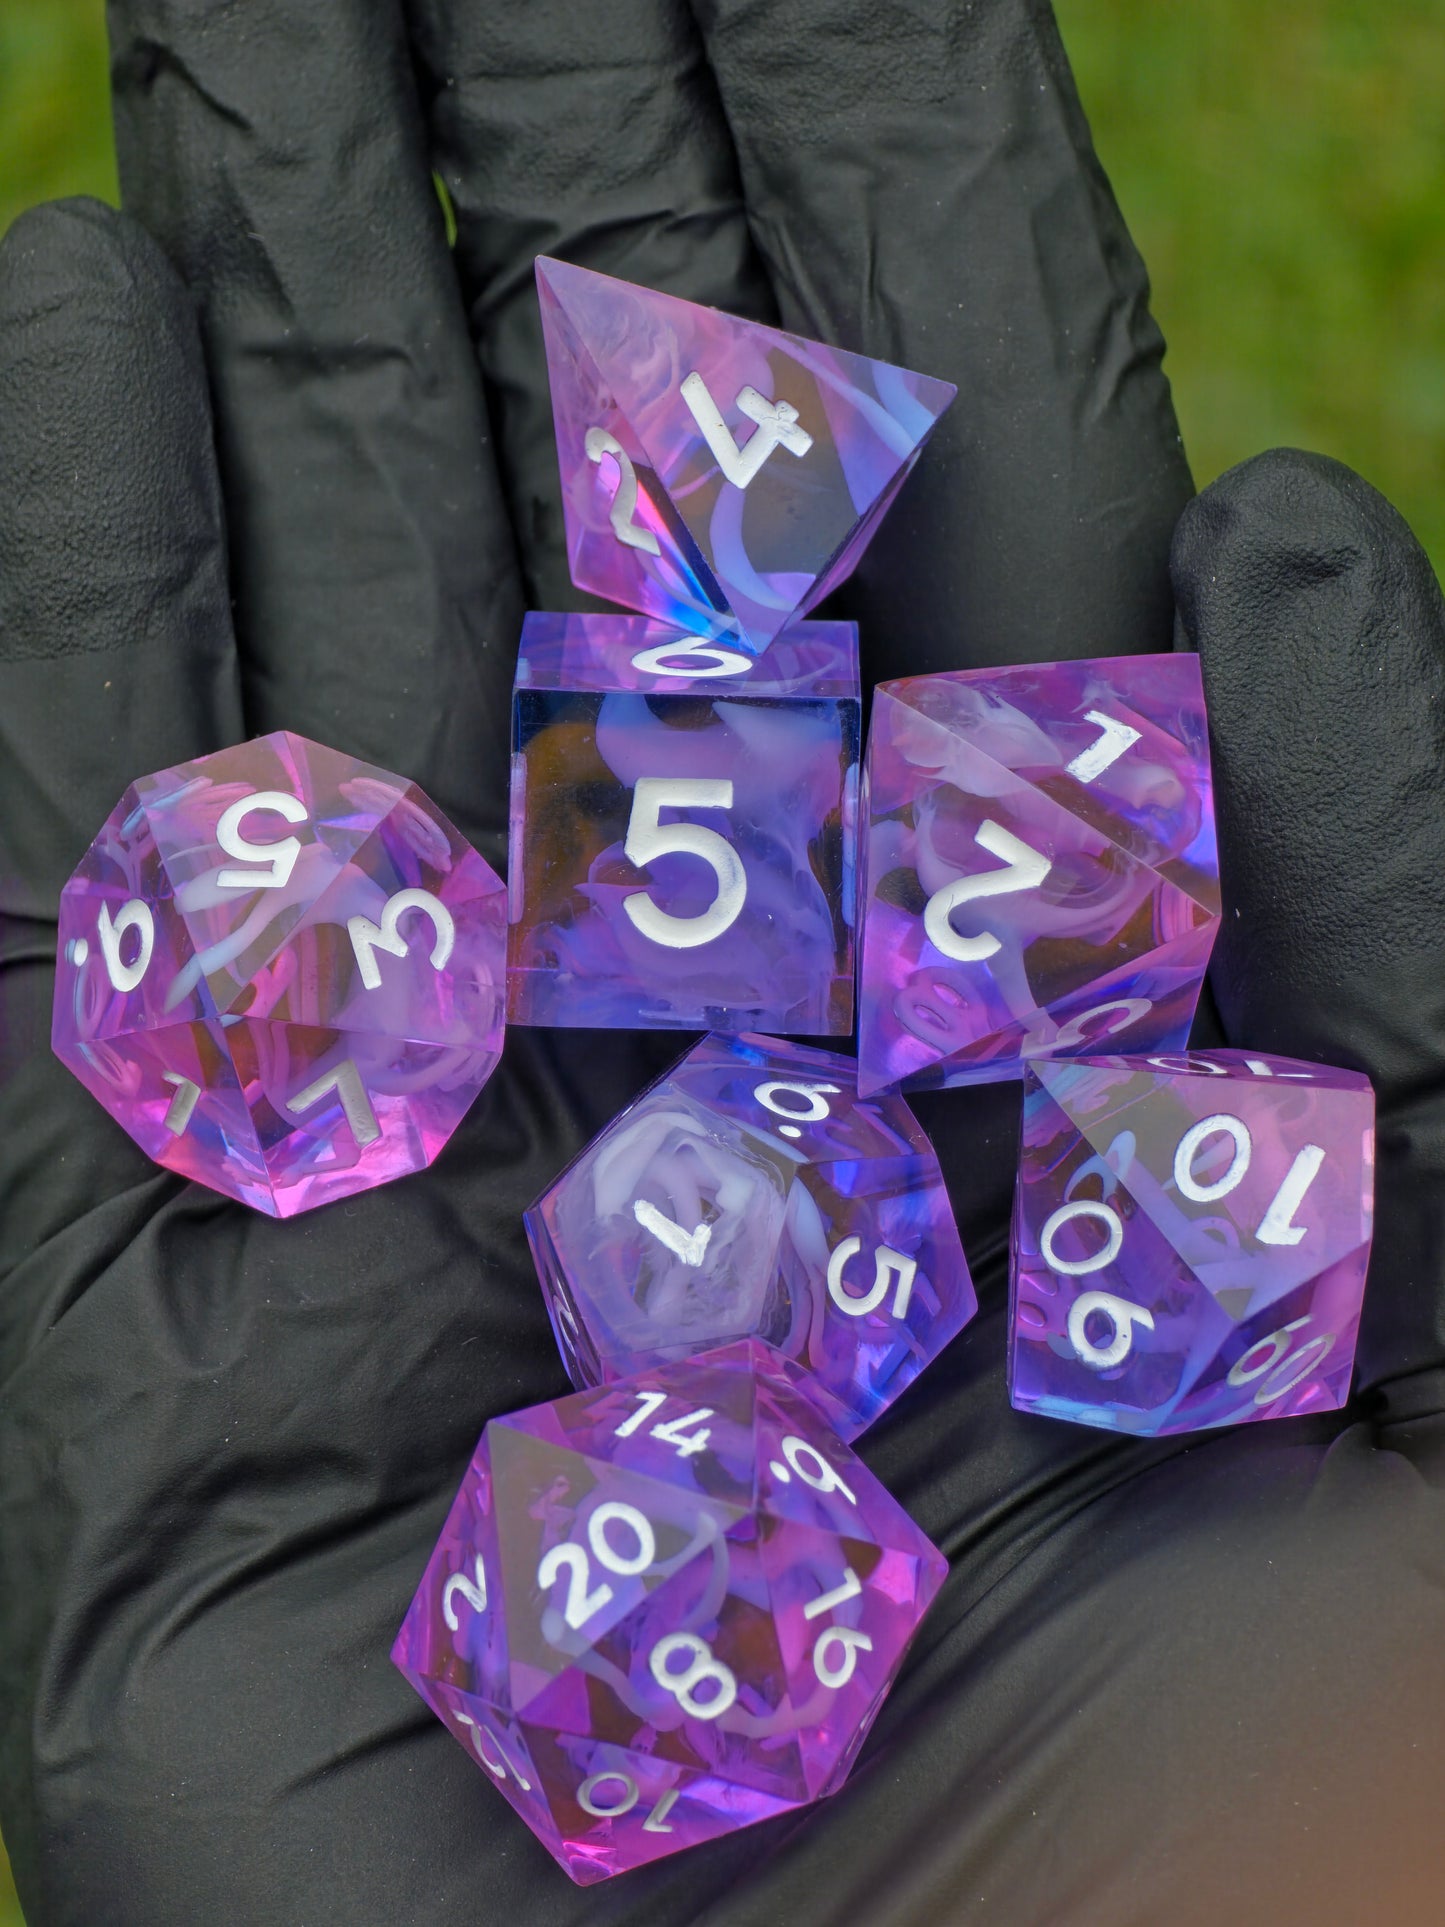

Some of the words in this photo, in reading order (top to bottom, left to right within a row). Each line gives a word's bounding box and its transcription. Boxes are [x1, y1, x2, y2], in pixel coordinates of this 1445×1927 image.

[680, 371, 813, 489] 4
[585, 427, 661, 556] 2
[631, 636, 753, 677] 6
[1064, 709, 1143, 784] 1
[216, 791, 308, 888] 5
[623, 777, 747, 949] 5
[346, 887, 455, 990] 3
[923, 818, 1052, 962] 2
[1173, 1112, 1326, 1246] 10
[633, 1199, 711, 1267] 1
[827, 1236, 918, 1320] 5
[615, 1391, 715, 1458] 14
[443, 1553, 488, 1631] 2
[538, 1502, 656, 1629] 20
[649, 1632, 737, 1720] 8
